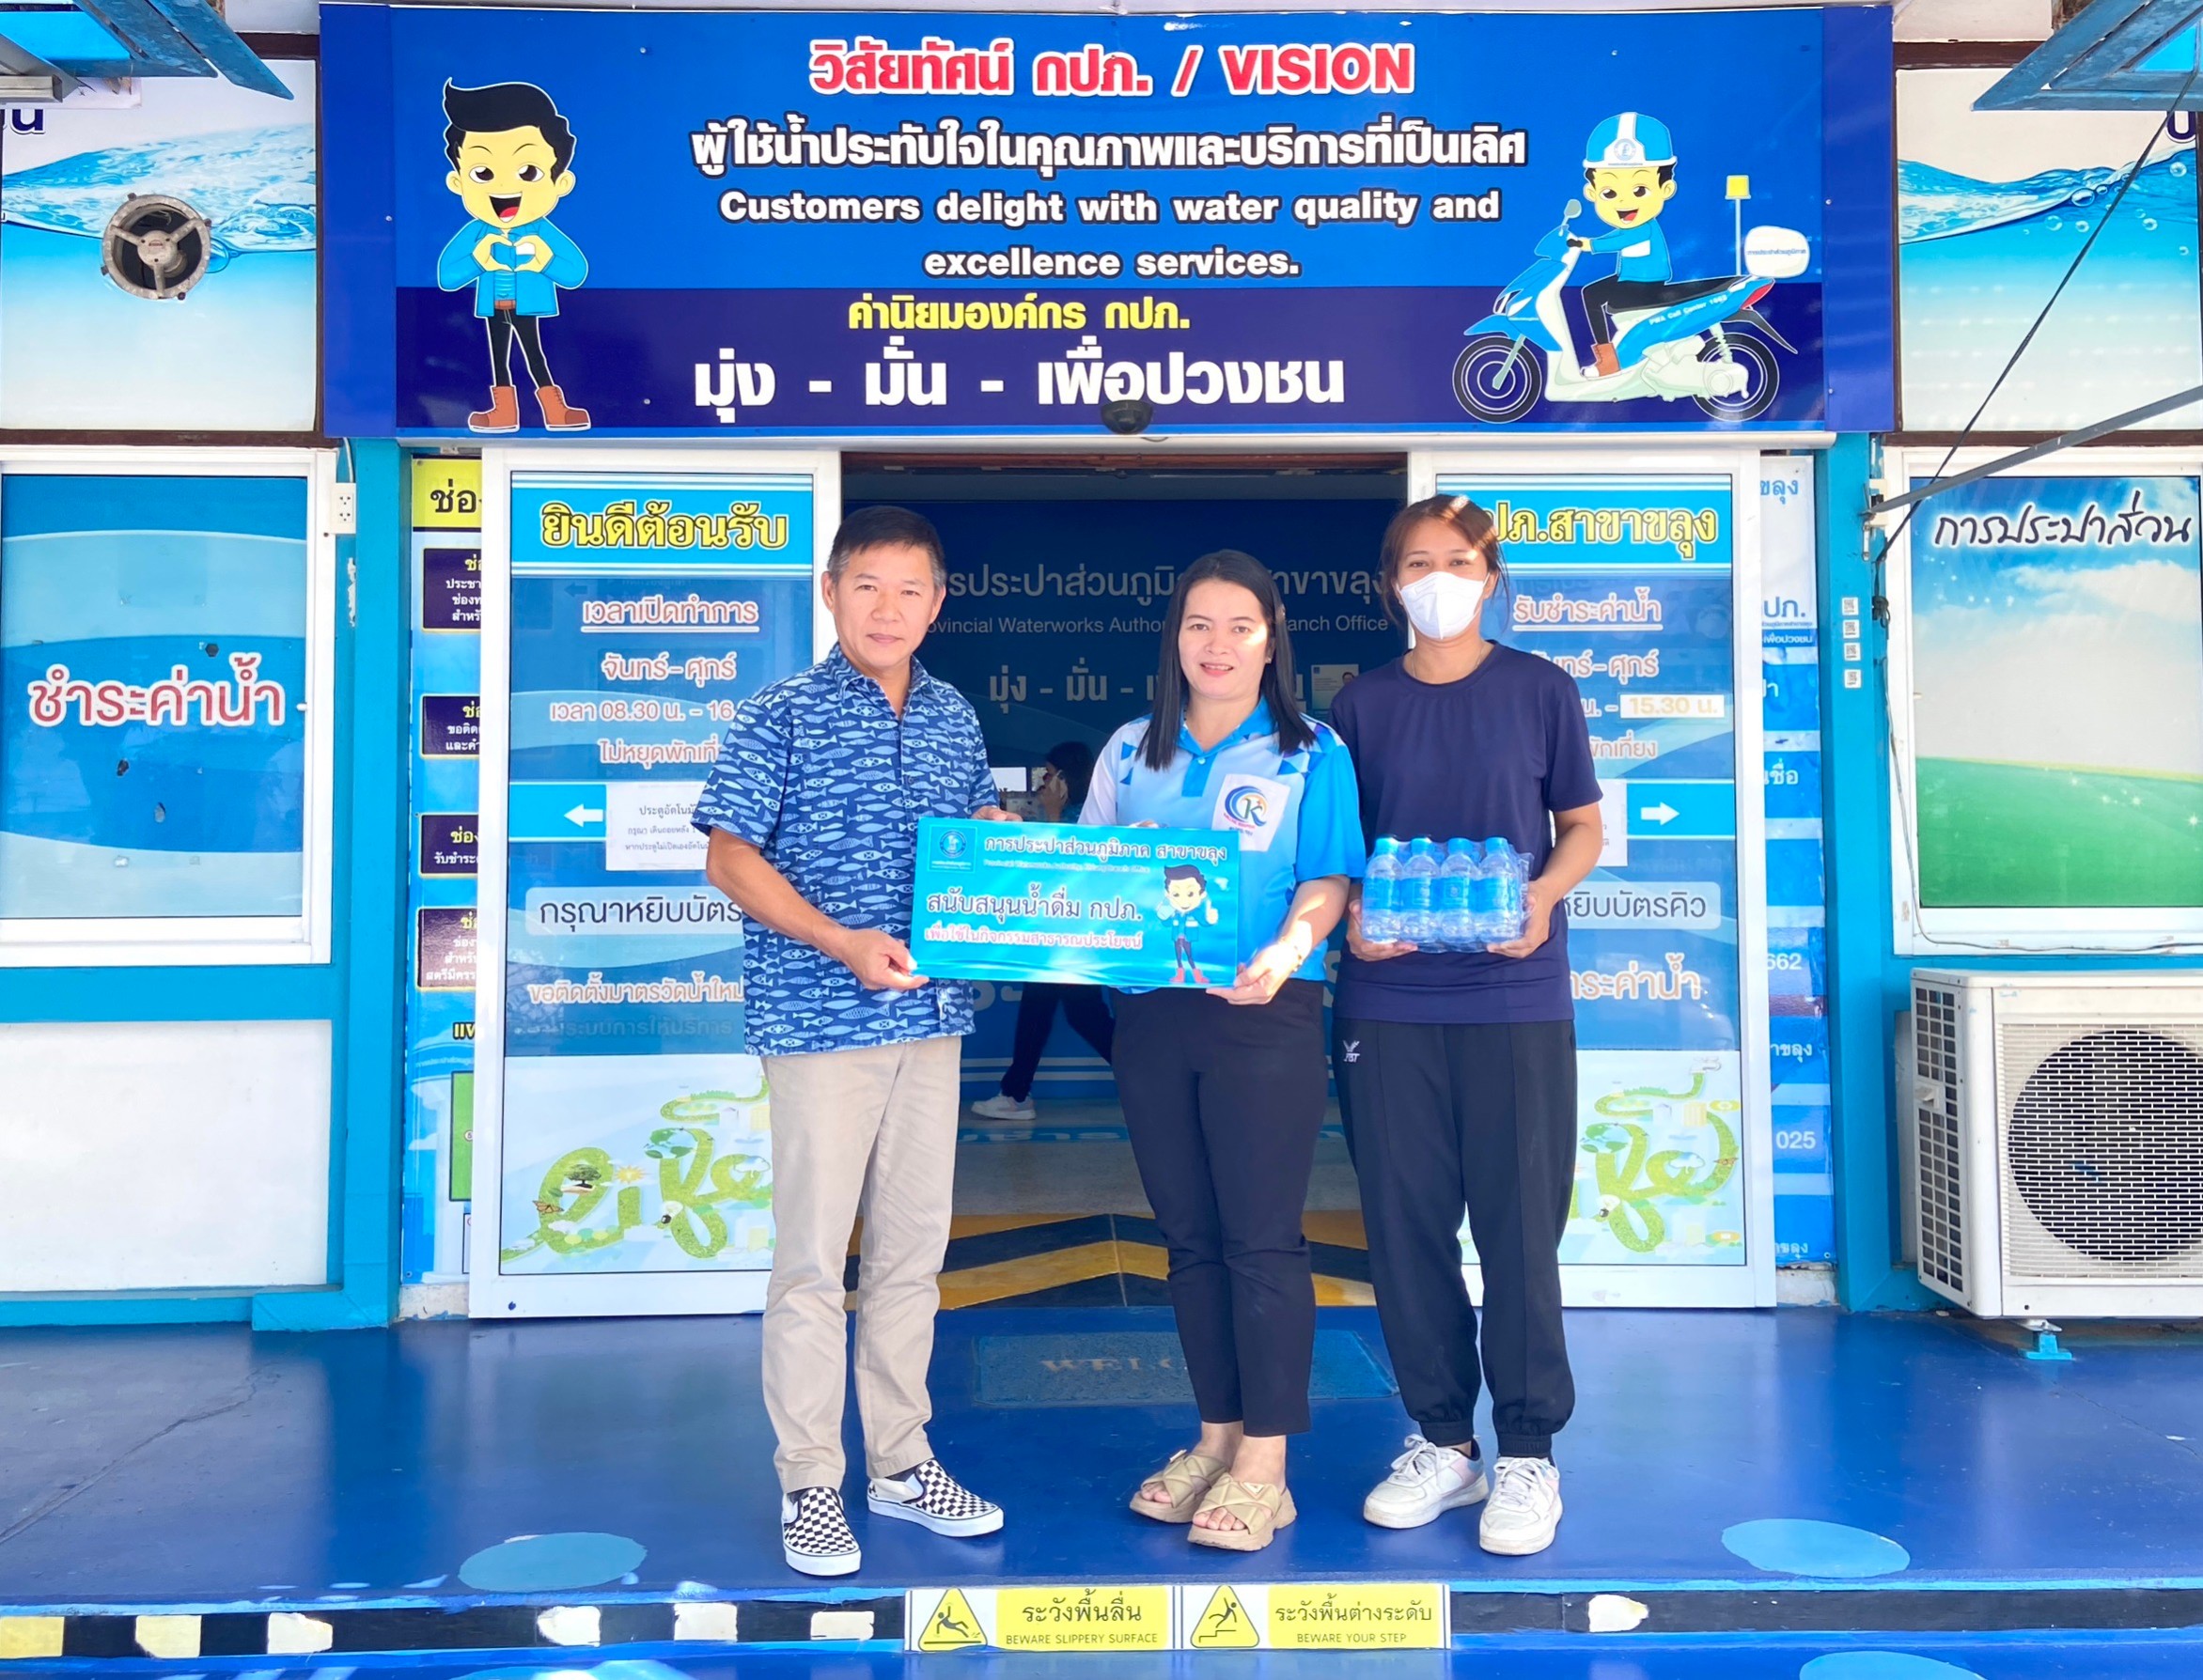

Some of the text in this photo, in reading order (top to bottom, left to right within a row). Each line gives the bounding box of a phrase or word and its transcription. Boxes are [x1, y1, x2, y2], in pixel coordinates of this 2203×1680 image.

[812, 38, 1412, 95] วิสัยทัศน์ กปภ. / VISION
[691, 114, 1525, 177] ผู้ใช้น้ำประทับใจในคุณภาพและบริการที่เป็นเลิศ
[721, 191, 1499, 226] Customers delight with water quality and
[925, 247, 1299, 275] excellence services.
[848, 292, 1191, 330] ค่านิยมองค์กร กปภ.
[695, 348, 776, 423] มุ่ง
[865, 335, 947, 407] มั่น
[1038, 335, 1345, 405] เพื่อปวงชน
[430, 478, 482, 514] ช่อ
[541, 501, 789, 549] ยินดีต้อนรับ
[1934, 490, 2192, 546] การประปาส่วน
[948, 564, 1182, 608] รประปาส่วนภูมิ
[582, 594, 758, 625] เวลาเปิดทำการ
[1513, 587, 1662, 622] รับชำระค่าน้ำ
[998, 615, 1104, 633] Waterworks
[1336, 614, 1388, 631] Office
[29, 654, 283, 724] ชำระค่าน้ำ
[990, 663, 1027, 713] มุ่ง
[1066, 658, 1108, 702] มั่น
[551, 702, 596, 721] เวลา
[601, 701, 660, 721] 08.30
[664, 703, 685, 721] น.
[1630, 697, 1689, 715] 15.30
[1697, 697, 1718, 715] น.
[599, 735, 721, 770] ไม่หยุดพักเที่
[433, 851, 478, 864] รับชำระ
[984, 834, 1227, 867] การประปาส่วนภูมิภาค สาขาขลุง
[927, 882, 1144, 923] สนับสนุนน้ำดื่ม กปภ.
[527, 972, 744, 1004] ขอติดตั้งมาตรวัดน้ำใหม
[1775, 1131, 1817, 1149] 025
[1021, 1588, 1143, 1624] ระวังพื้นลื่น
[1274, 1594, 1433, 1624] ระวังพื้นต่างระดับ
[1006, 1632, 1159, 1645] BEWARE SLIPPERY SURFACE
[1296, 1633, 1408, 1644] BEWARE YOUR STEP
